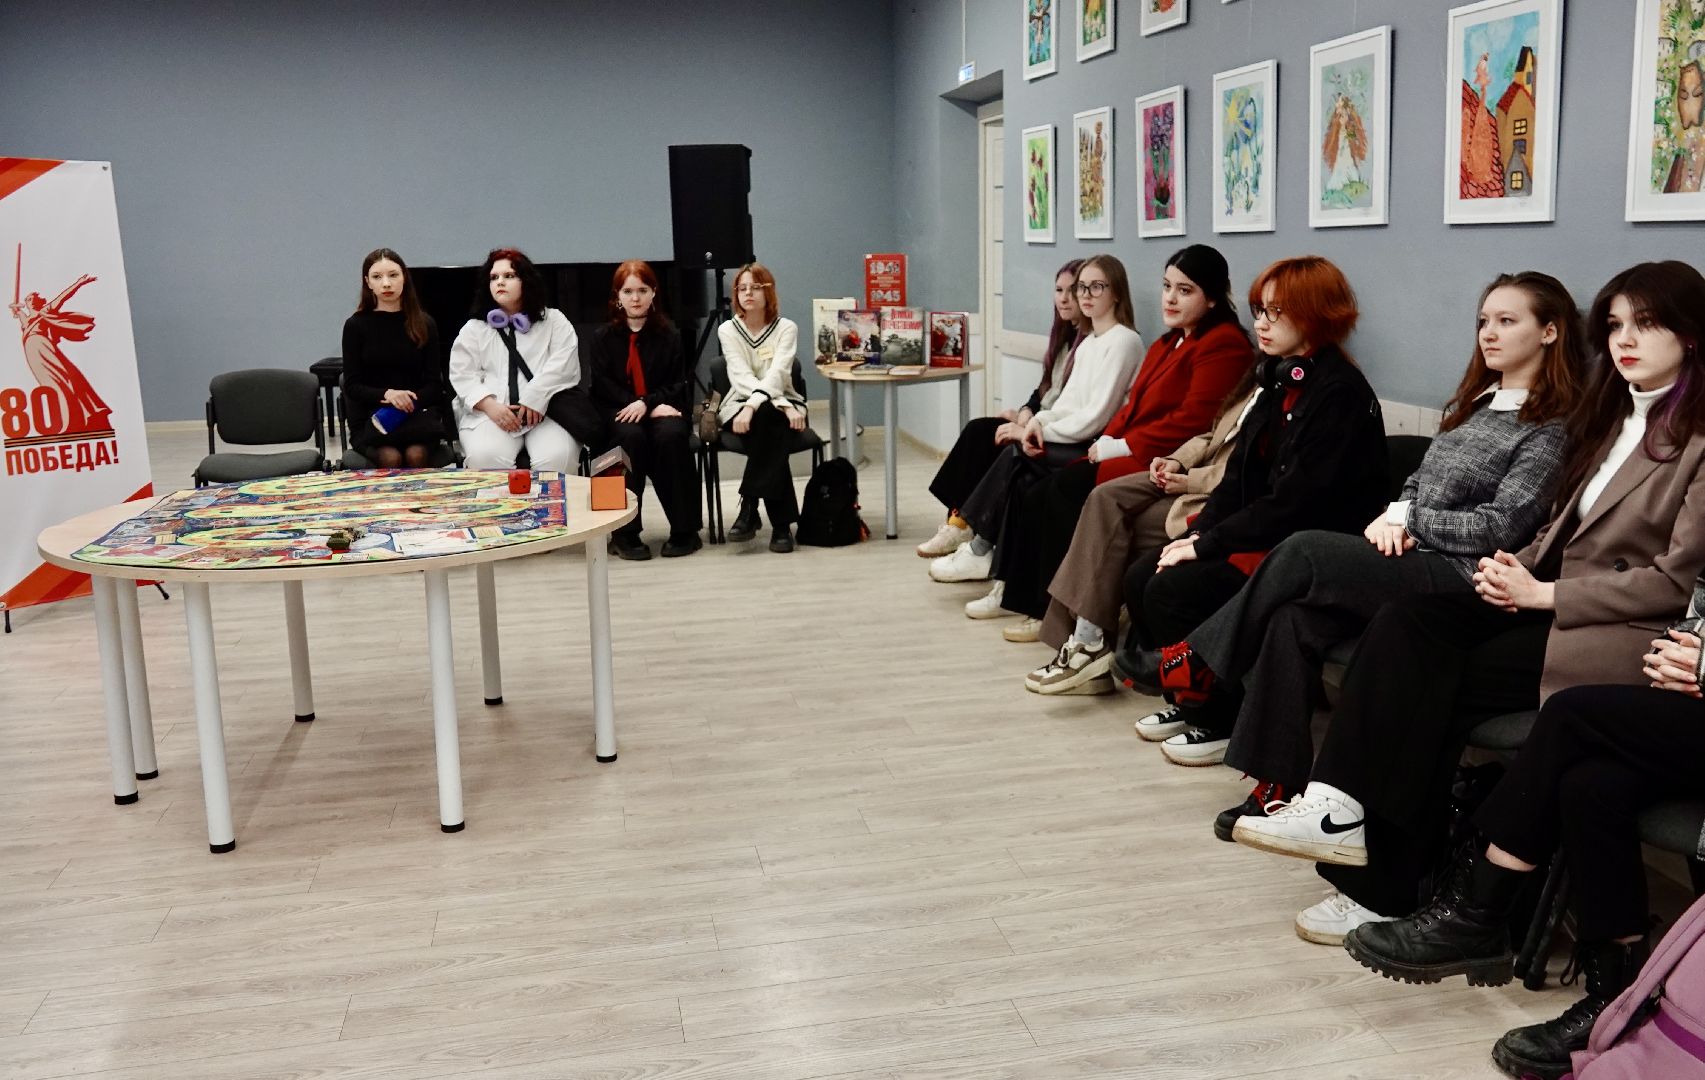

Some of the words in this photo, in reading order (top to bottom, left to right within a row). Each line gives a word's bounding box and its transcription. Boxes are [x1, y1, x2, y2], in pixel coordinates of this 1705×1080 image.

[870, 289, 901, 302] 1945
[0, 385, 63, 439] 80
[5, 440, 119, 476] ПОБЕДА!
